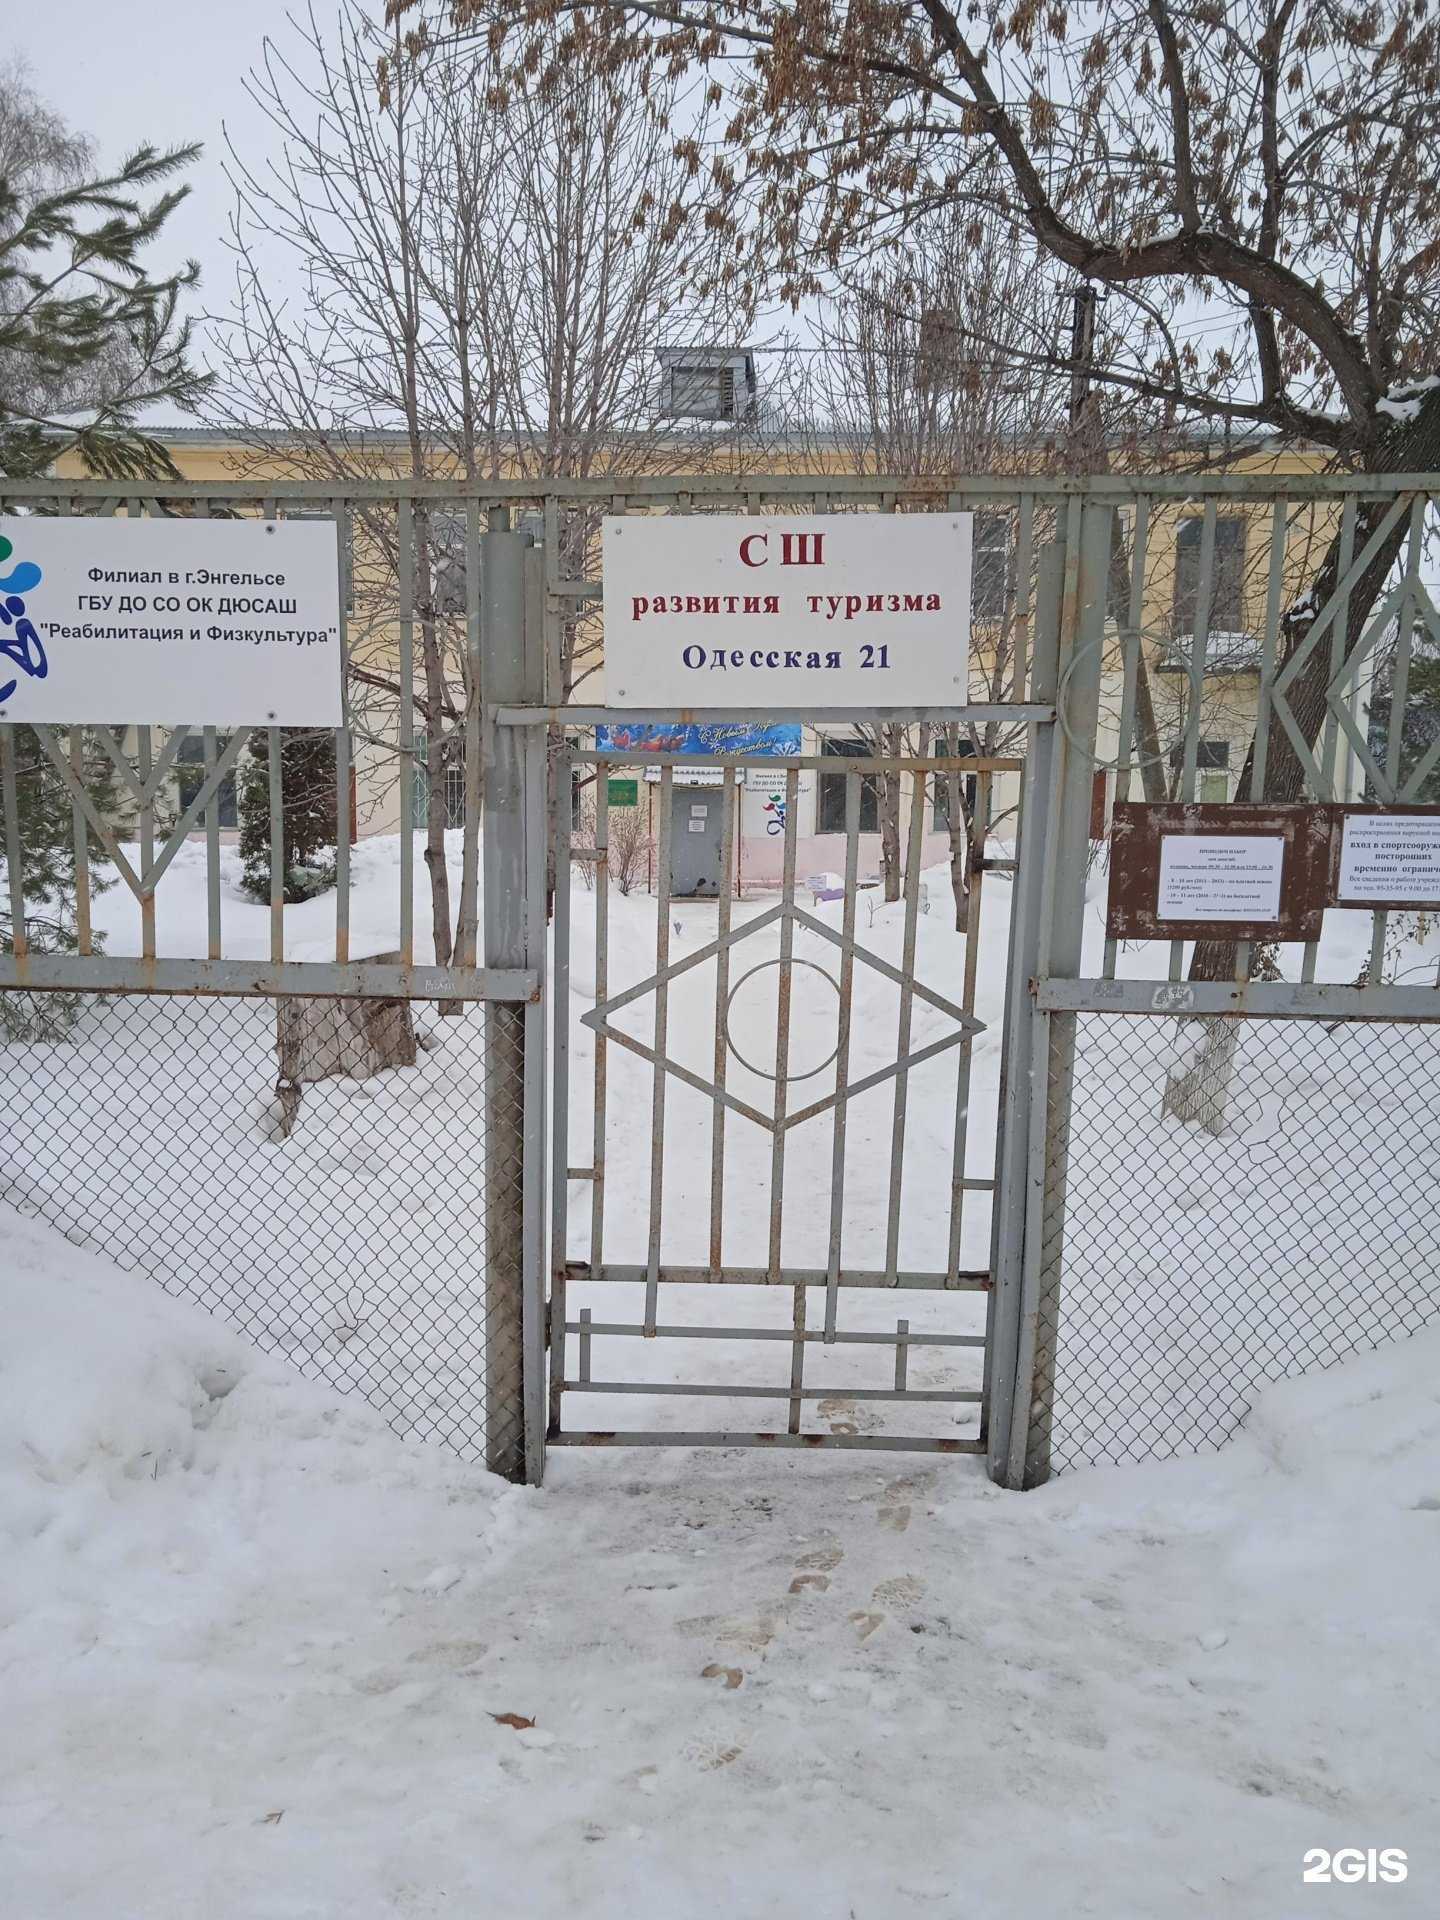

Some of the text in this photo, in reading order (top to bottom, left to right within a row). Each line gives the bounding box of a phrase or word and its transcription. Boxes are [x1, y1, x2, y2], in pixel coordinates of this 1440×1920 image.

[88, 567, 286, 586] Филиал в г.Энгельсе
[78, 595, 297, 615] ГБУ ДО СО ОК ДЮСАШ
[632, 593, 942, 620] развития туризма
[40, 622, 337, 646] "Реабилитация и Физкультура"
[682, 644, 891, 671] Одесская 21
[1375, 853, 1432, 861] посторонних
[1354, 865, 1397, 873] временно
